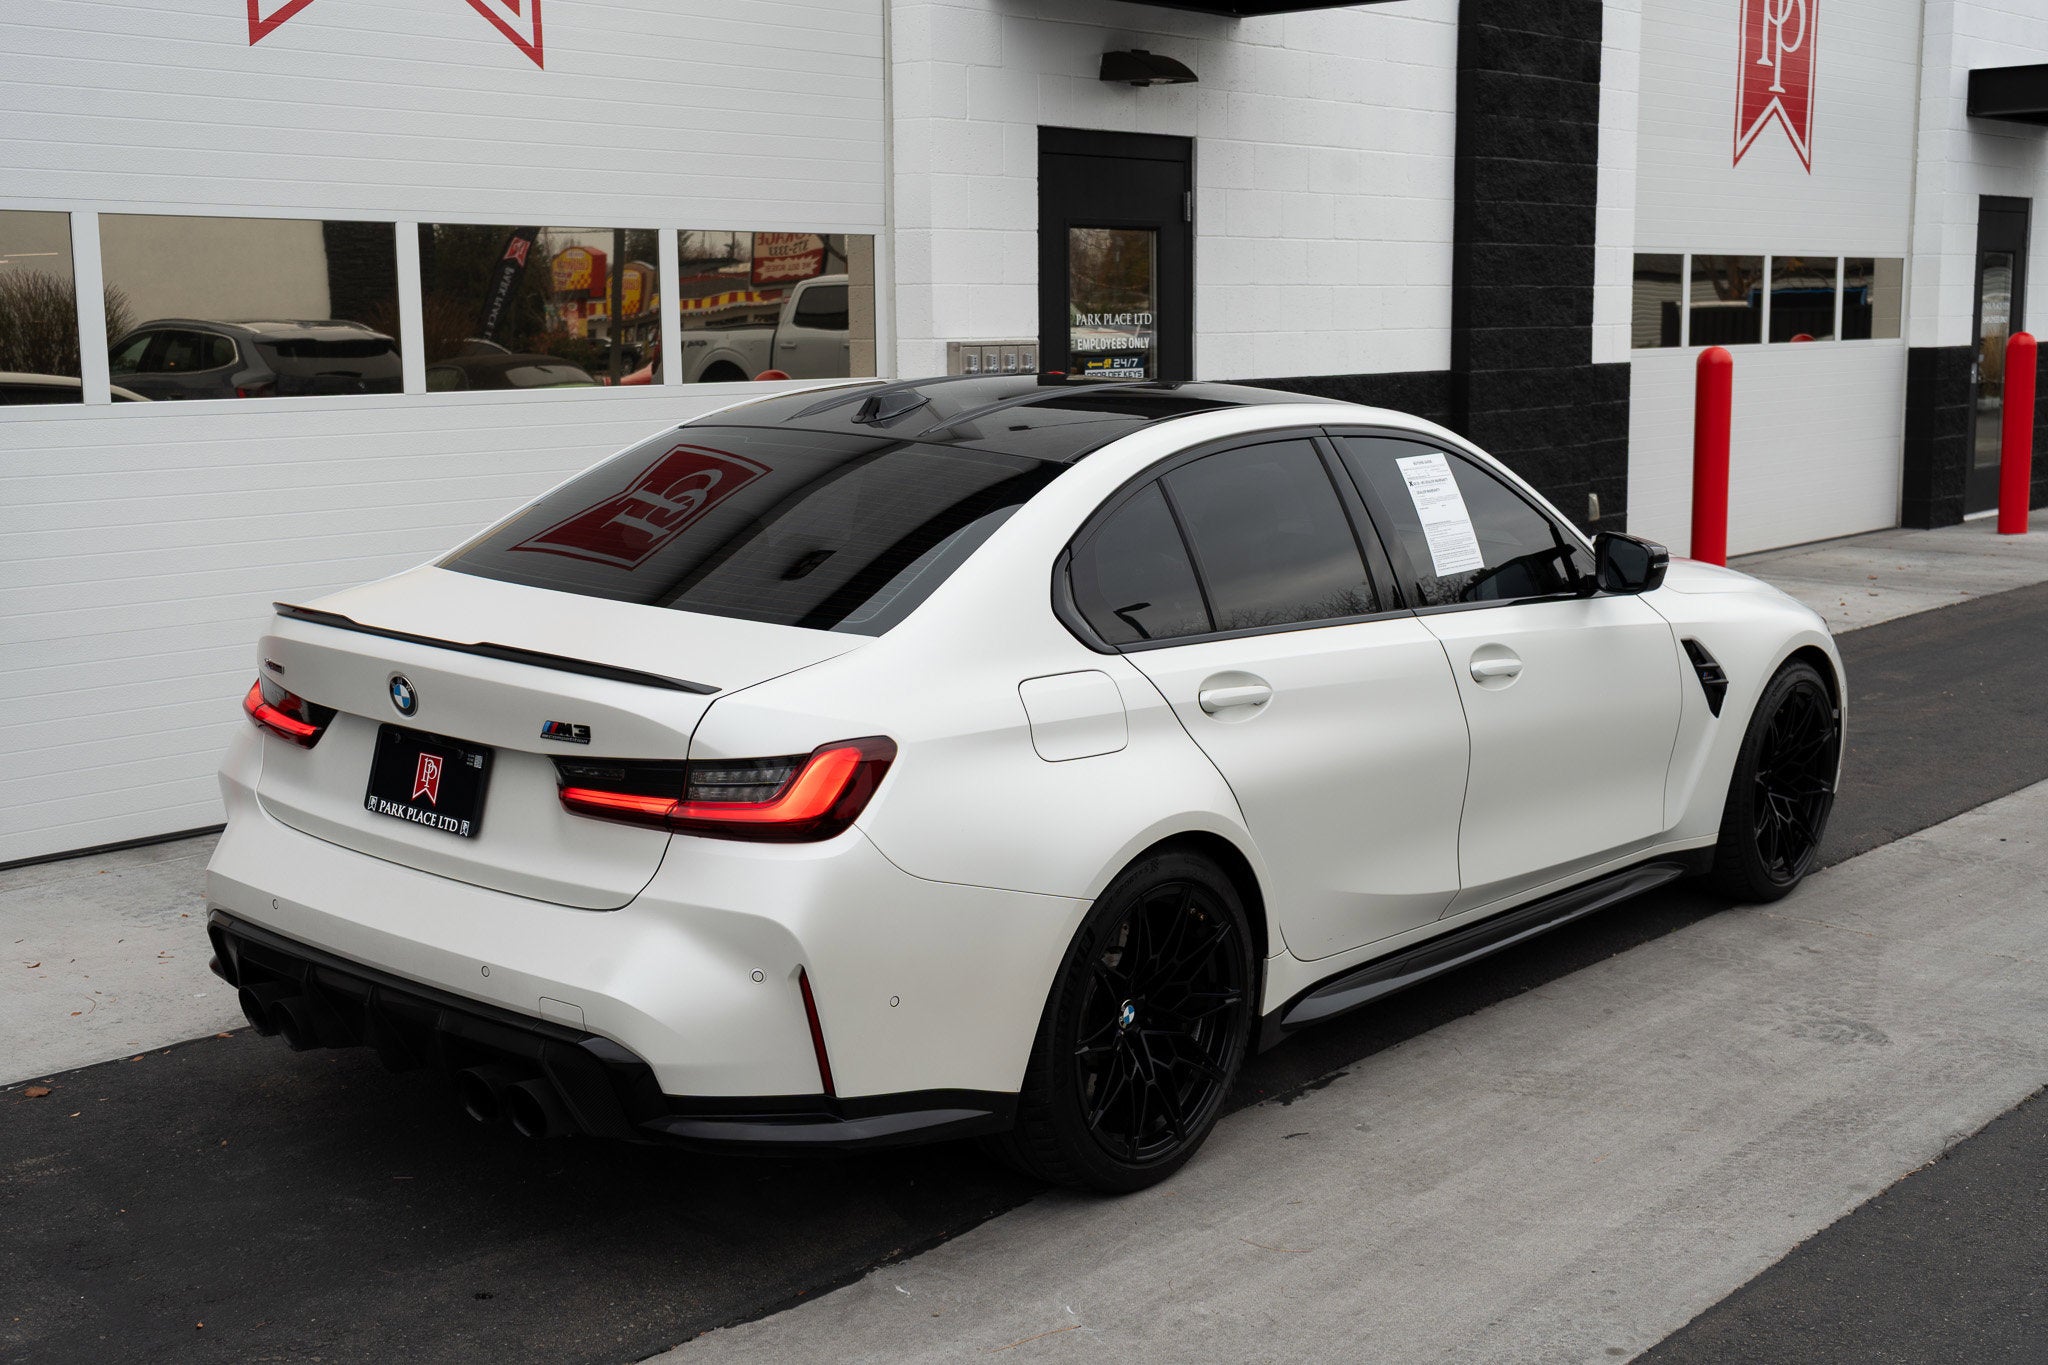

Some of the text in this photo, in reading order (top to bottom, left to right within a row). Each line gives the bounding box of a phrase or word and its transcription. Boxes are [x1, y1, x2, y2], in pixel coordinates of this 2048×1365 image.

[1076, 313, 1153, 326] PARK PLACE LTD
[1077, 337, 1150, 351] EMPLOYEES ONLY
[1113, 358, 1138, 368] 24/7
[1123, 370, 1142, 378] KEYS
[546, 720, 591, 738] M3
[378, 800, 406, 818] PARK
[406, 807, 438, 827] PLACE
[437, 815, 458, 832] LTD
